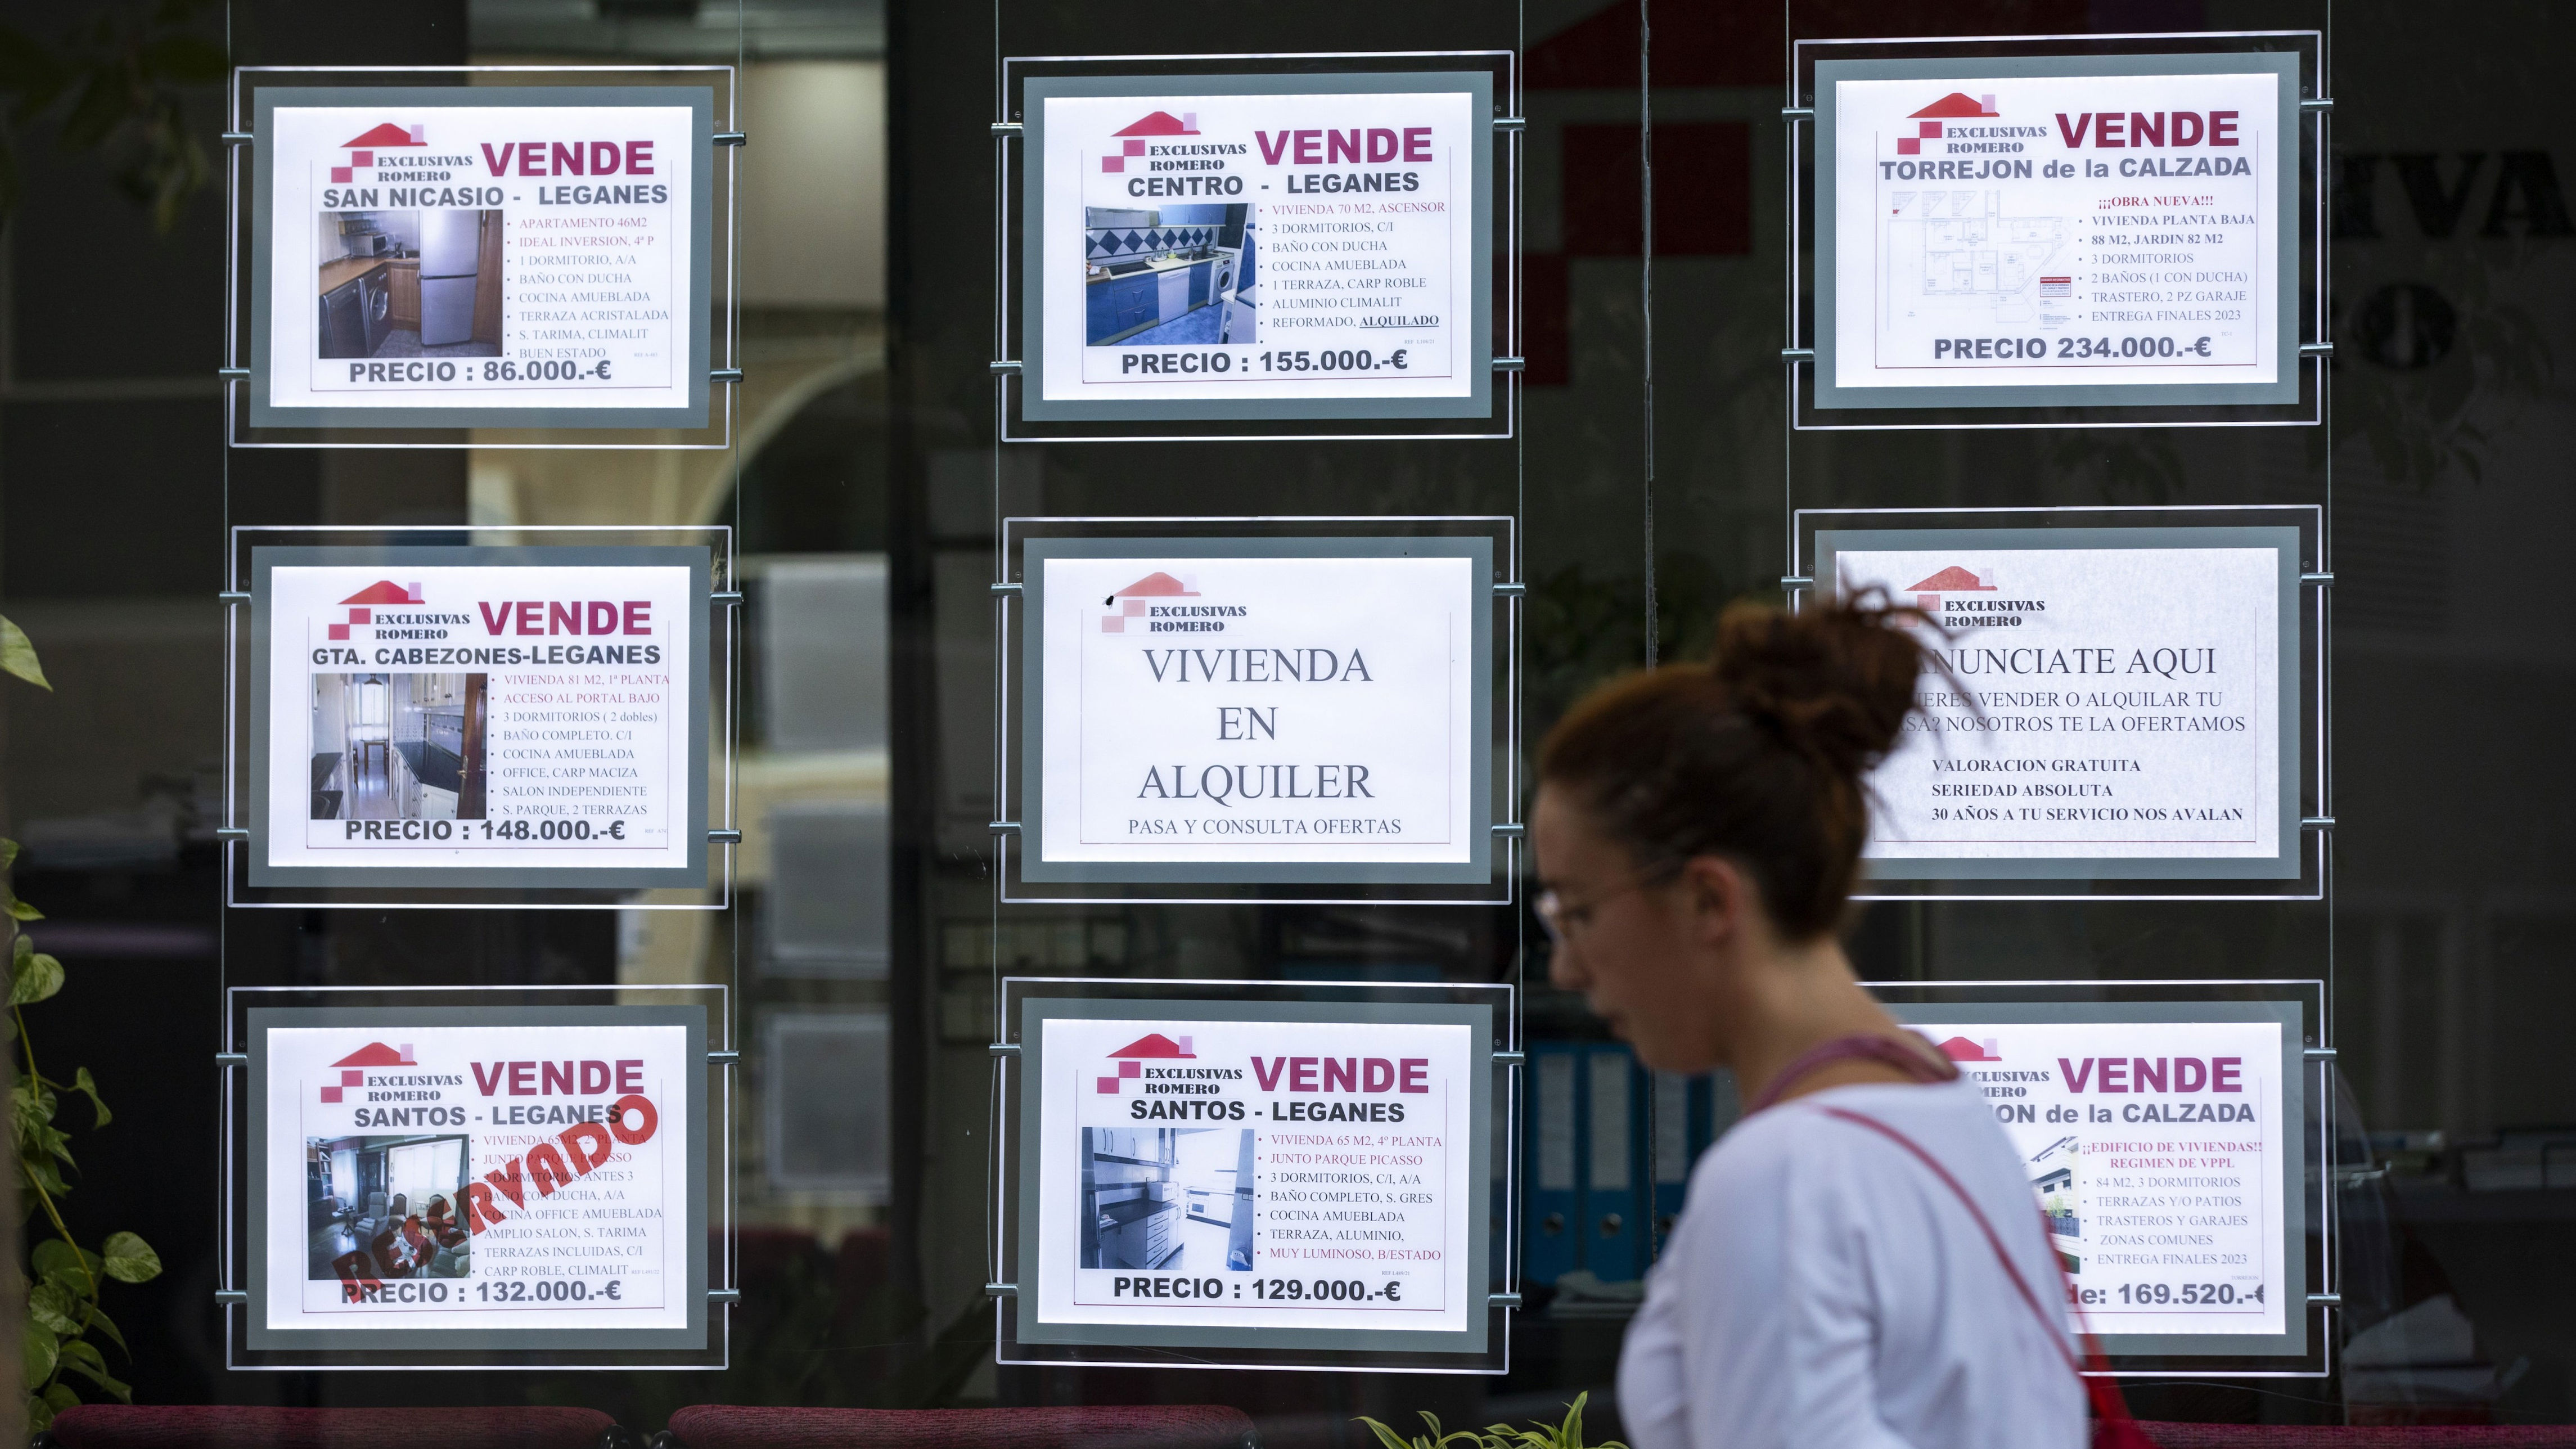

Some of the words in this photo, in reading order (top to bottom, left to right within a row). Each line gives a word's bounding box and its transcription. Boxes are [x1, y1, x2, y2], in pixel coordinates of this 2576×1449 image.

[1947, 127, 2047, 138] EXCLUSIVAS
[2055, 111, 2239, 148] VENDE
[1150, 144, 1246, 156] EXCLUSIVAS
[1255, 127, 1432, 165] VENDE
[1947, 142, 2024, 153] ROMERO
[378, 156, 472, 166] EXCLUSIVAS
[481, 141, 654, 177] VENDE
[1150, 160, 1224, 171] ROMERO
[1880, 160, 2032, 180] TORREJON
[2043, 160, 2075, 178] de
[2086, 159, 2109, 178] la
[2119, 157, 2251, 177] CALZADA
[378, 171, 451, 182] ROMERO
[1128, 175, 1242, 197] CENTRO
[1288, 172, 1418, 194] LEGANES
[323, 188, 378, 208] SAN
[390, 187, 503, 206] NICASIO
[539, 184, 668, 205] LEGANES
[1273, 205, 1334, 214] VIVIENDA
[1339, 205, 1350, 213] 70
[1355, 204, 1374, 213] M2,
[1379, 202, 1445, 213] ASCENSOR
[520, 218, 614, 228] APARTAMENTO
[618, 217, 647, 227] 46M2
[2092, 216, 2158, 226] VIVIENDA
[2163, 215, 2217, 225] PLANTA
[2221, 215, 2254, 224] BAJA
[2092, 236, 2104, 245] 88
[2109, 235, 2130, 245] M2,
[2134, 235, 2183, 244] JARDIN
[2188, 234, 2200, 244] 82
[2205, 234, 2223, 243] M2
[1273, 240, 1308, 252] BAÑO
[1312, 242, 1337, 251] CON
[1343, 241, 1387, 251] DUCHA
[1272, 261, 1320, 271] COCINA
[1325, 260, 1406, 270] AMUEBLADA
[520, 272, 555, 284] BAÑO
[558, 274, 583, 284] CON
[588, 273, 632, 283] DUCHA
[520, 293, 566, 302] COCINA
[571, 292, 650, 302] AMUEBLADA
[1273, 299, 1337, 308] ALUMINIO
[1341, 297, 1402, 307] CLIMALIT
[520, 311, 576, 321] TERRAZA
[581, 310, 668, 320] ACRISTALADA
[2092, 311, 2152, 321] ENTREGA
[2158, 310, 2211, 321] FINALES
[2215, 310, 2240, 320] 2023
[1273, 317, 1355, 327] REFORMADO,
[1359, 316, 1439, 328] ALQUILADO
[1935, 338, 2046, 359] PRECIO
[2057, 336, 2211, 358] 234.000.-€
[1123, 353, 1231, 374] PRECIO
[1260, 349, 1407, 371] 155.000.-€
[350, 362, 456, 382] PRECIO
[484, 360, 611, 381] 86.000.-€
[1150, 606, 1246, 616] EXCLUSIVAS
[1945, 601, 2044, 611] EXCLUSIVAS
[376, 614, 470, 624] EXCLUSIVAS
[478, 601, 651, 636] VENDE
[1944, 616, 2022, 627] ROMERO
[1150, 622, 1224, 632] ROMERO
[376, 629, 448, 639] ROMERO
[313, 649, 366, 665] GTA.
[375, 645, 660, 664] CABEZONES-LEGANES
[1142, 648, 1373, 682] VIVIENDA
[2125, 649, 2216, 680] AQUI
[505, 694, 552, 703] ACCESO
[557, 694, 572, 703] AL
[577, 694, 624, 703] PORTAL
[629, 694, 659, 703] BAJO
[1978, 692, 2060, 708] VENDER
[2066, 692, 2079, 706] O
[2086, 692, 2190, 710] ALQUILAR
[2196, 692, 2222, 706] TU
[1217, 707, 1278, 740] EN
[1947, 716, 2052, 732] NOSOTROS
[2059, 717, 2083, 731] TE
[2090, 717, 2115, 731] LA
[2122, 717, 2245, 731] OFERTAMOS
[503, 749, 550, 759] COCINA
[555, 749, 634, 758] AMUEBLADA
[1933, 760, 2046, 771] VALORACION
[2052, 760, 2141, 771] GRATUITA
[1137, 765, 1375, 807] ALQUILER
[1933, 785, 2017, 796] SERIEDAD
[2023, 785, 2113, 796] ABSOLUTA
[1932, 808, 1948, 820] 30
[1953, 806, 1998, 820] AÑOS
[2003, 809, 2014, 820] A
[2019, 809, 2041, 820] TU
[2047, 808, 2128, 820] SERVICIO
[2134, 808, 2167, 820] NOS
[2172, 809, 2242, 820] AVALAN
[346, 820, 452, 840] PRECIO
[481, 820, 625, 840] 148.000.-€
[1129, 820, 1178, 834] PASA
[1184, 820, 1197, 834] Y
[1203, 820, 1308, 834] CONSULTA
[1314, 819, 1400, 834] OFERTAS
[470, 1060, 645, 1096] VENDE
[1145, 1068, 1242, 1079] EXCLUSIVAS
[1250, 1056, 1429, 1094] VENDE
[2057, 1058, 2242, 1093] VENDE
[368, 1076, 462, 1086] EXCLUSIVAS
[1145, 1084, 1220, 1094] ROMERO
[368, 1091, 440, 1101] ROMERO
[354, 1107, 466, 1127] SANTOS
[493, 1104, 622, 1125] LEGANES
[1131, 1100, 1245, 1120] SANTOS
[1273, 1102, 1404, 1122] LEGANES
[2046, 1104, 2078, 1123] de
[2089, 1104, 2112, 1123] la
[2123, 1104, 2255, 1123] CALZADA
[1272, 1135, 1333, 1145] VIVIENDA
[1337, 1136, 1349, 1145] 65
[1354, 1136, 1373, 1146] M2,
[1392, 1137, 1441, 1146] PLANTA
[2158, 1142, 2174, 1151] DE
[2111, 1158, 2173, 1168] REGIMEN
[2179, 1158, 2196, 1168] DE
[2200, 1158, 2234, 1167] VPPL
[1271, 1210, 1319, 1220] COCINA
[1323, 1212, 1404, 1221] AMUEBLADA
[1270, 1230, 1332, 1240] TERRAZA,
[1336, 1231, 1404, 1241] ALUMINIO,
[2101, 1235, 2144, 1245] ZONAS
[2148, 1235, 2213, 1245] COMUNES
[1271, 1248, 1299, 1258] MUY
[1304, 1249, 1373, 1260] LUMINOSO,
[1379, 1250, 1440, 1260] B/ESTADO
[485, 1267, 517, 1276] CARP
[521, 1266, 565, 1276] ROBLE,
[569, 1265, 628, 1275] CLIMALIT
[341, 1282, 448, 1304] PRECIO
[477, 1280, 621, 1302] 132.000.-€
[1114, 1277, 1223, 1298] PRECIO
[1253, 1279, 1400, 1301] 129.000.-€
